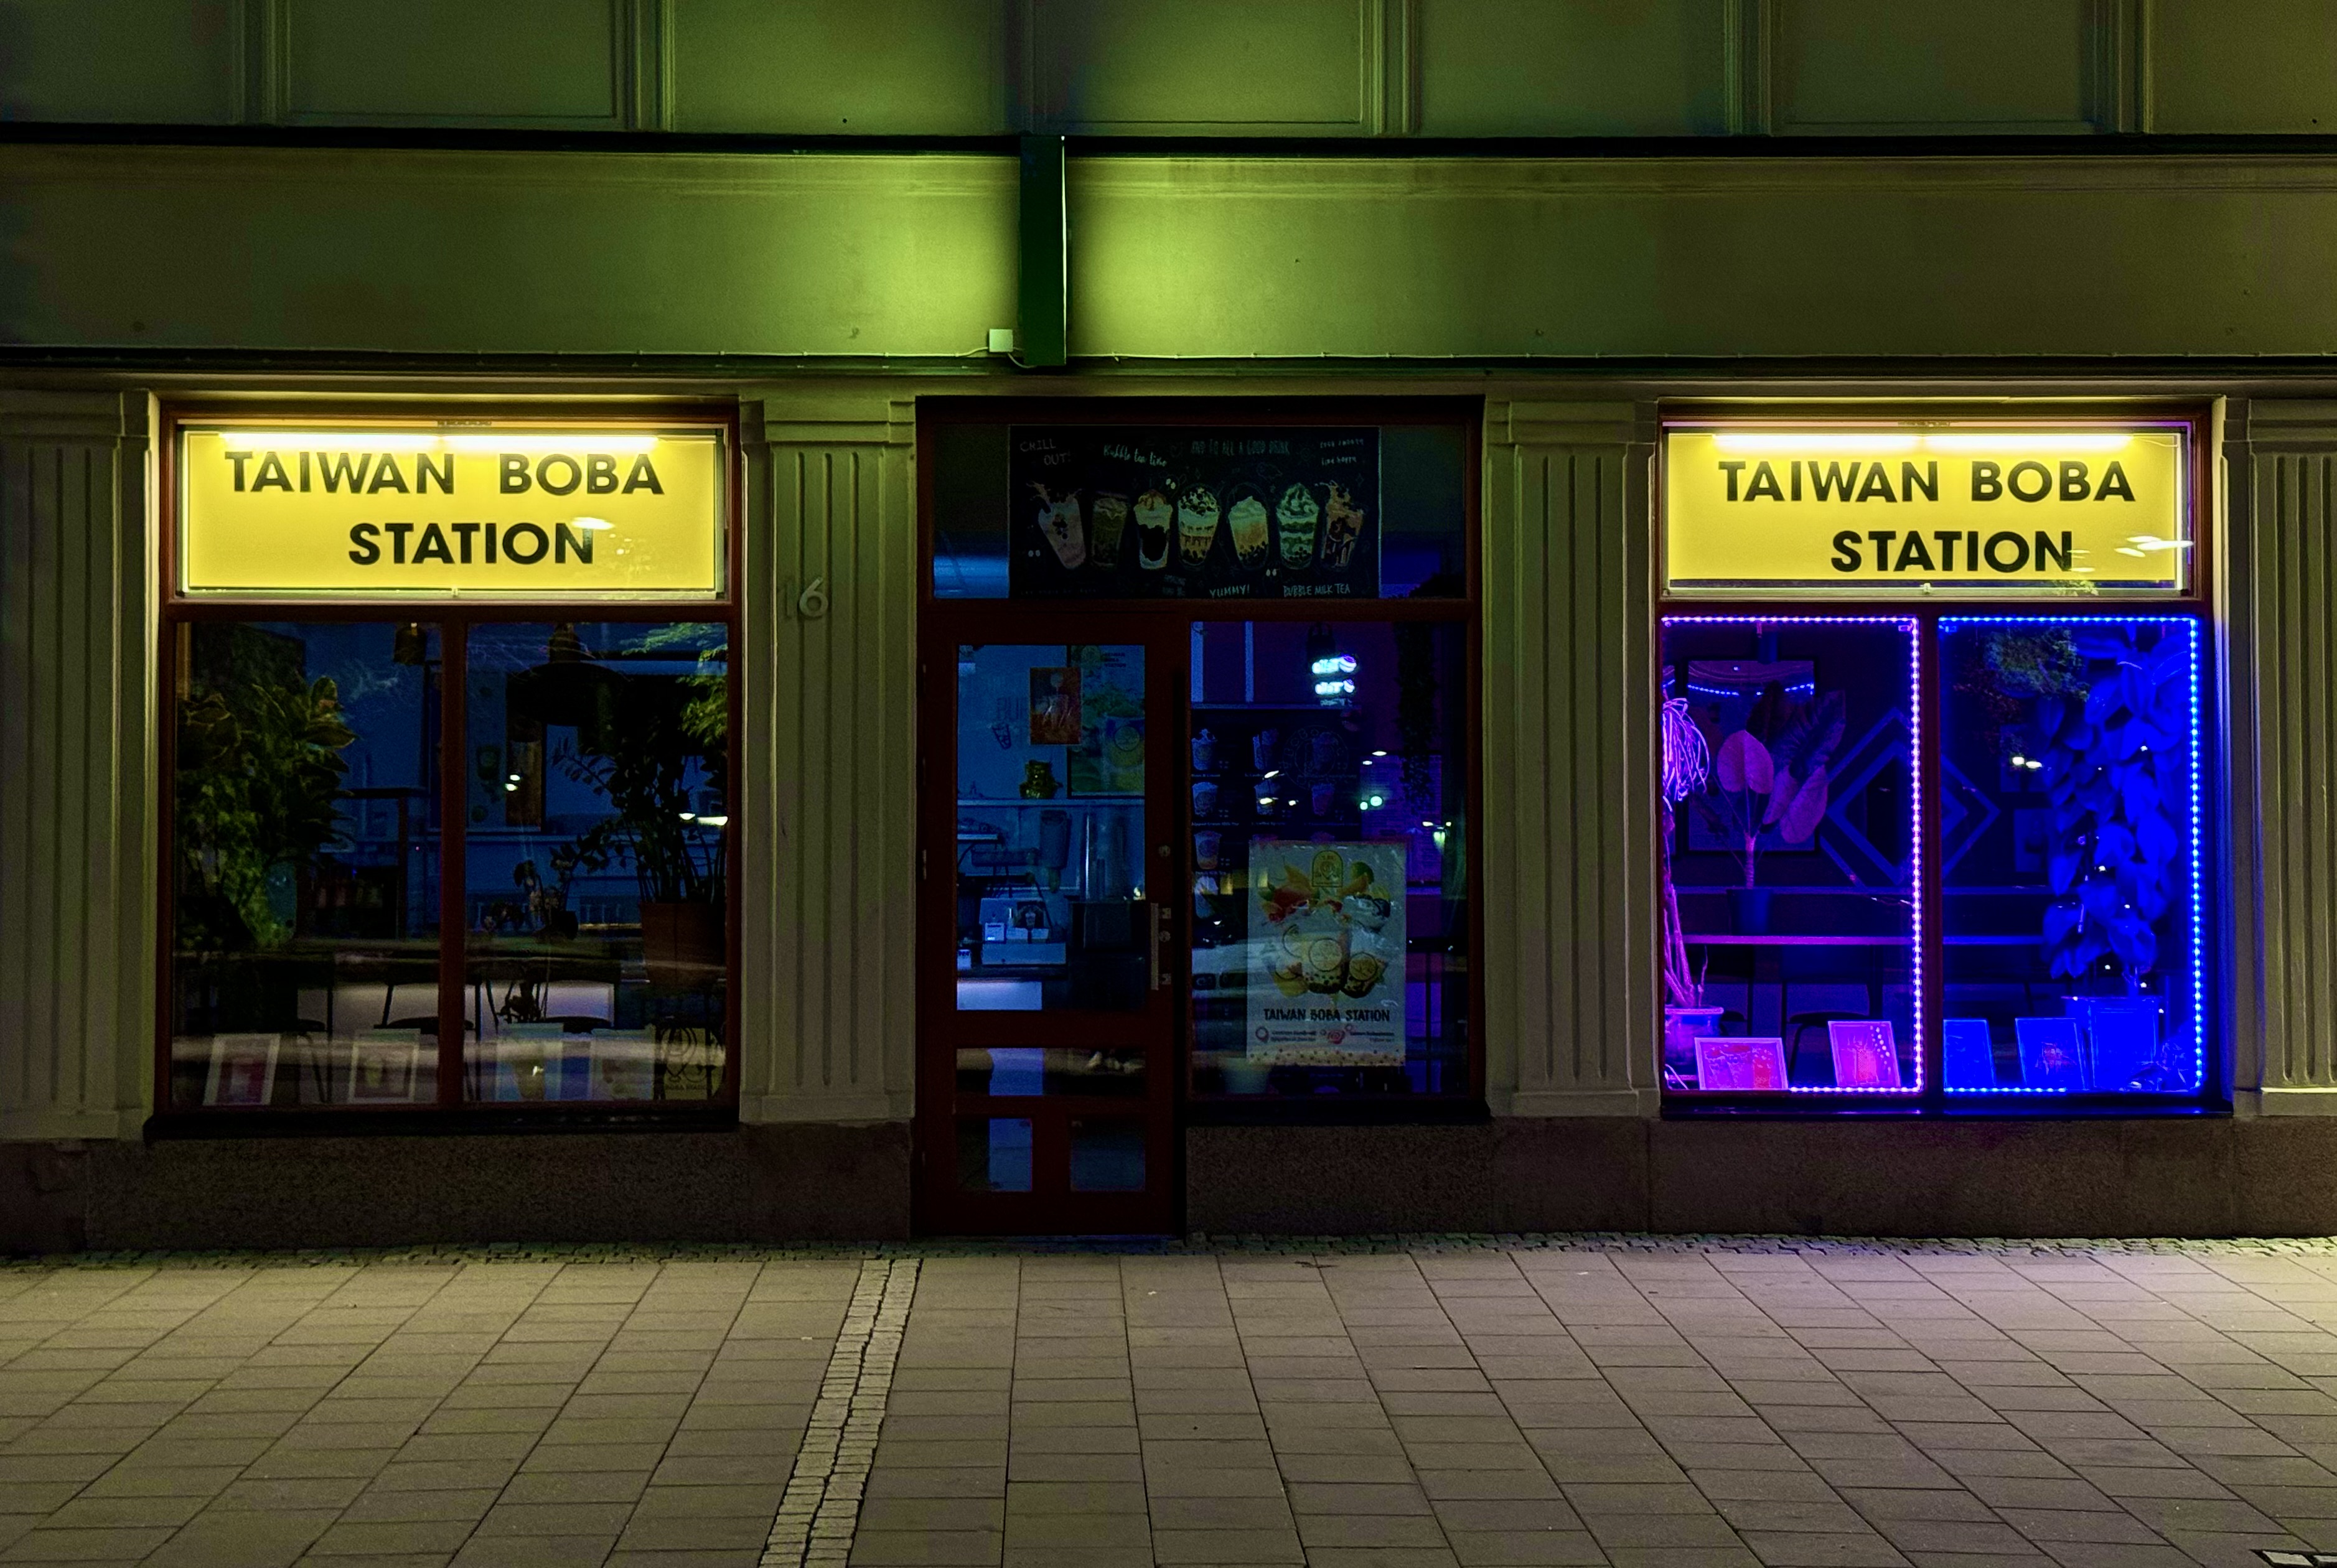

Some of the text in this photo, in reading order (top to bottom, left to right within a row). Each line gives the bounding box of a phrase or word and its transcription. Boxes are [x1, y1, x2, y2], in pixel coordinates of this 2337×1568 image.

[1019, 438, 1057, 452] CHILL
[225, 452, 664, 496] TAIWAN BOBA
[1718, 460, 2135, 503] TAIWAN BOBA
[349, 522, 594, 566] STATION
[1831, 530, 2072, 572] STATION
[1209, 584, 1250, 599] YUMMY!
[1314, 585, 1333, 595] MILK
[1334, 584, 1351, 595] TEA
[1263, 1009, 1390, 1022] TAIWAN BOBA STATION
